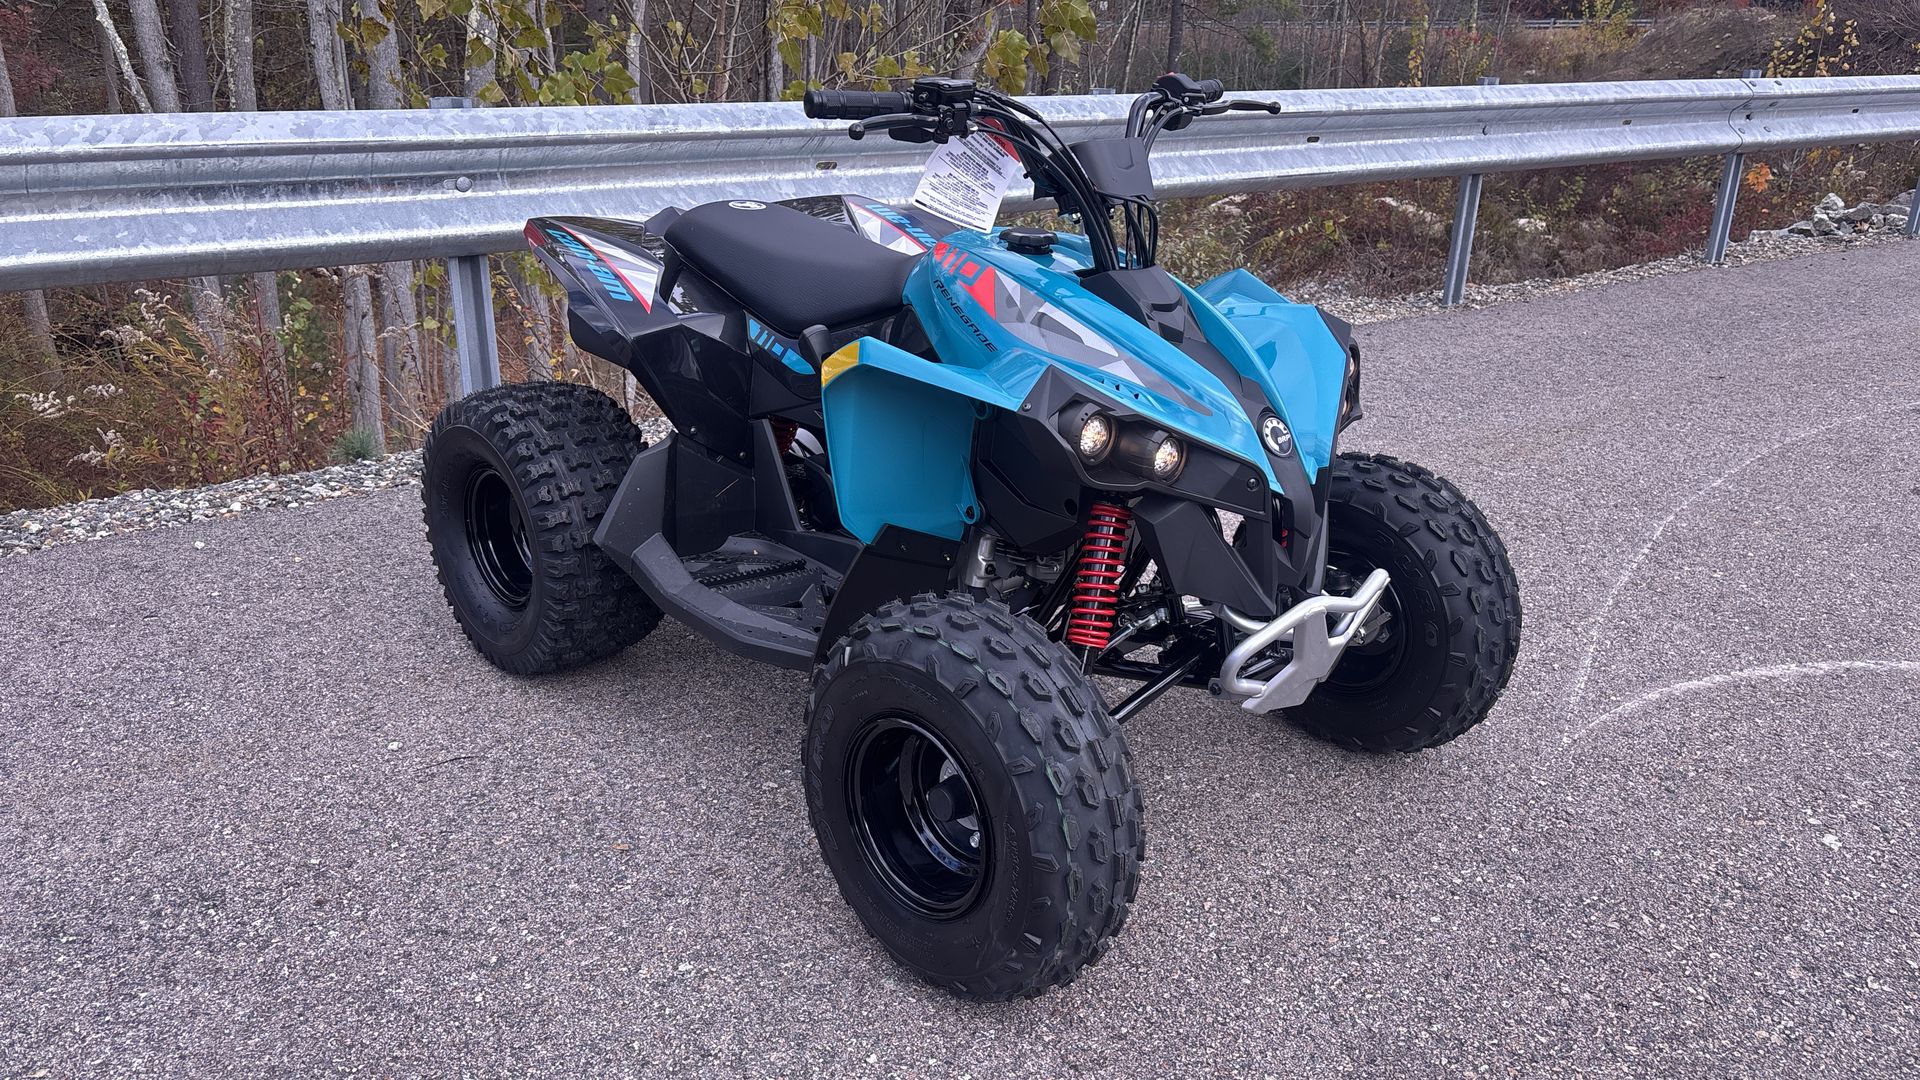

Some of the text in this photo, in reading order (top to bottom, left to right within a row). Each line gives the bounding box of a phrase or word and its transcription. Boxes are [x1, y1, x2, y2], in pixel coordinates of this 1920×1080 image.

[865, 204, 938, 248] an-am
[546, 229, 633, 302] can-am
[933, 279, 998, 353] RENEGADE
[1278, 434, 1291, 444] BRP
